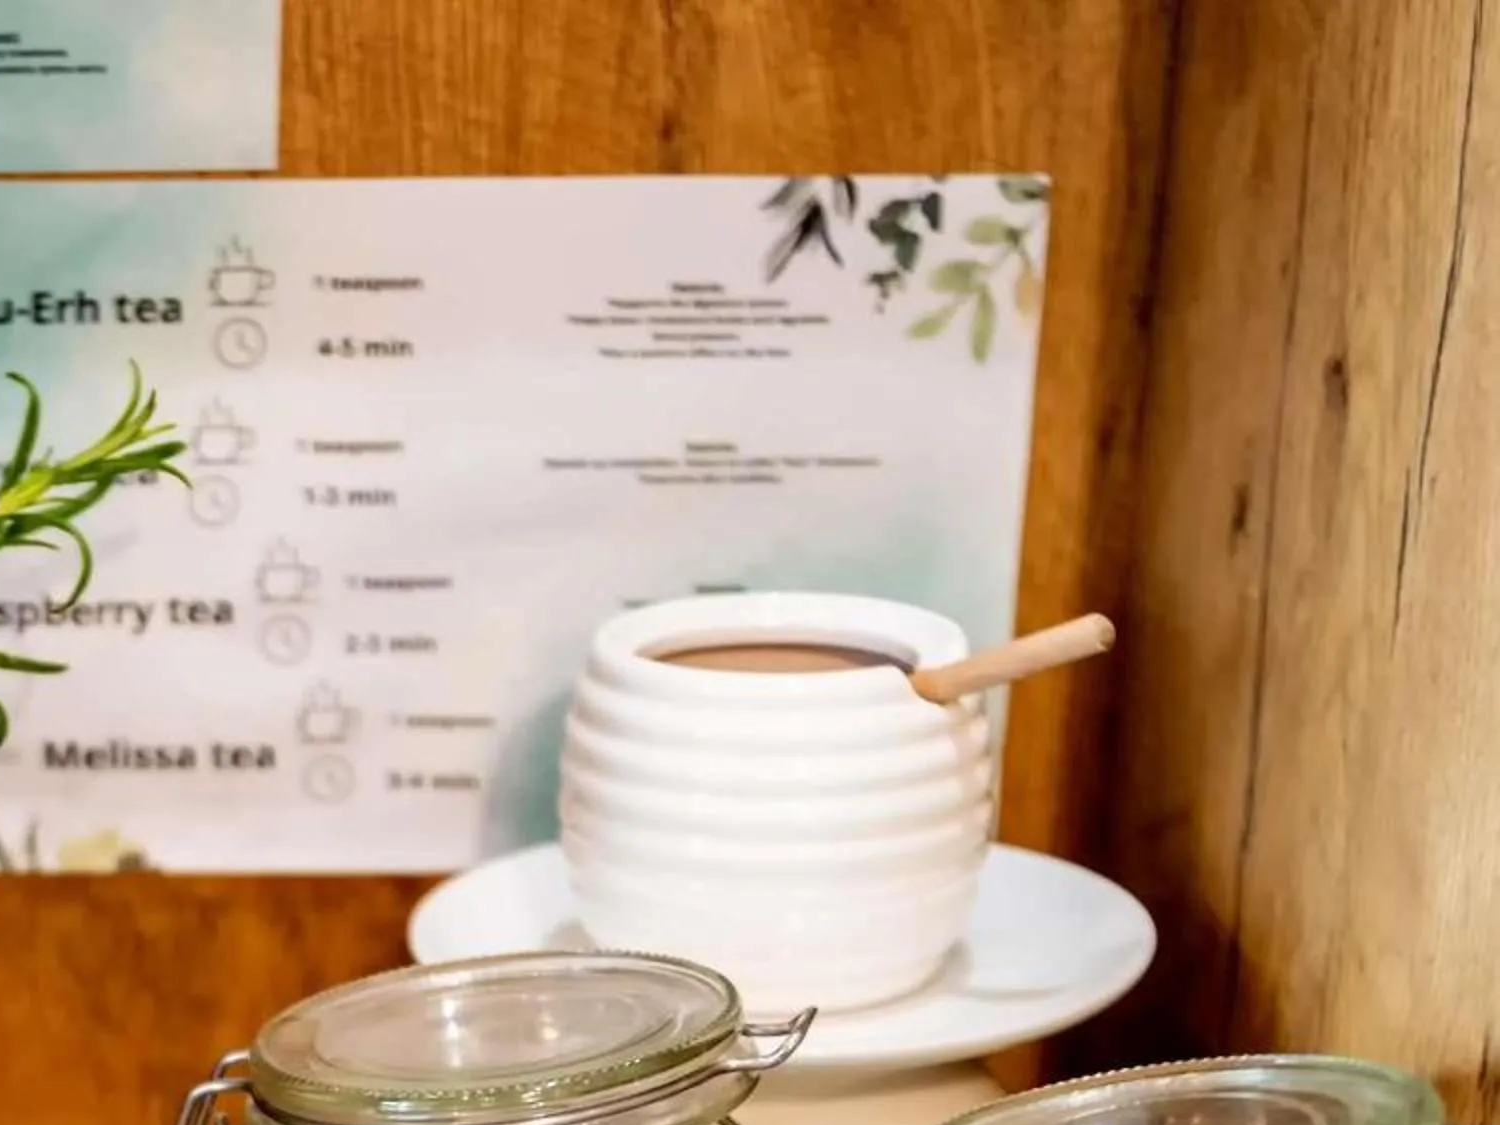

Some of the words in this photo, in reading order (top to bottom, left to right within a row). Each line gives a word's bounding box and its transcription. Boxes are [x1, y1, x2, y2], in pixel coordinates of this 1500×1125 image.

[114, 296, 183, 324] tea
[168, 598, 235, 625] tea
[43, 739, 198, 770] Melissa
[210, 741, 277, 769] tea
